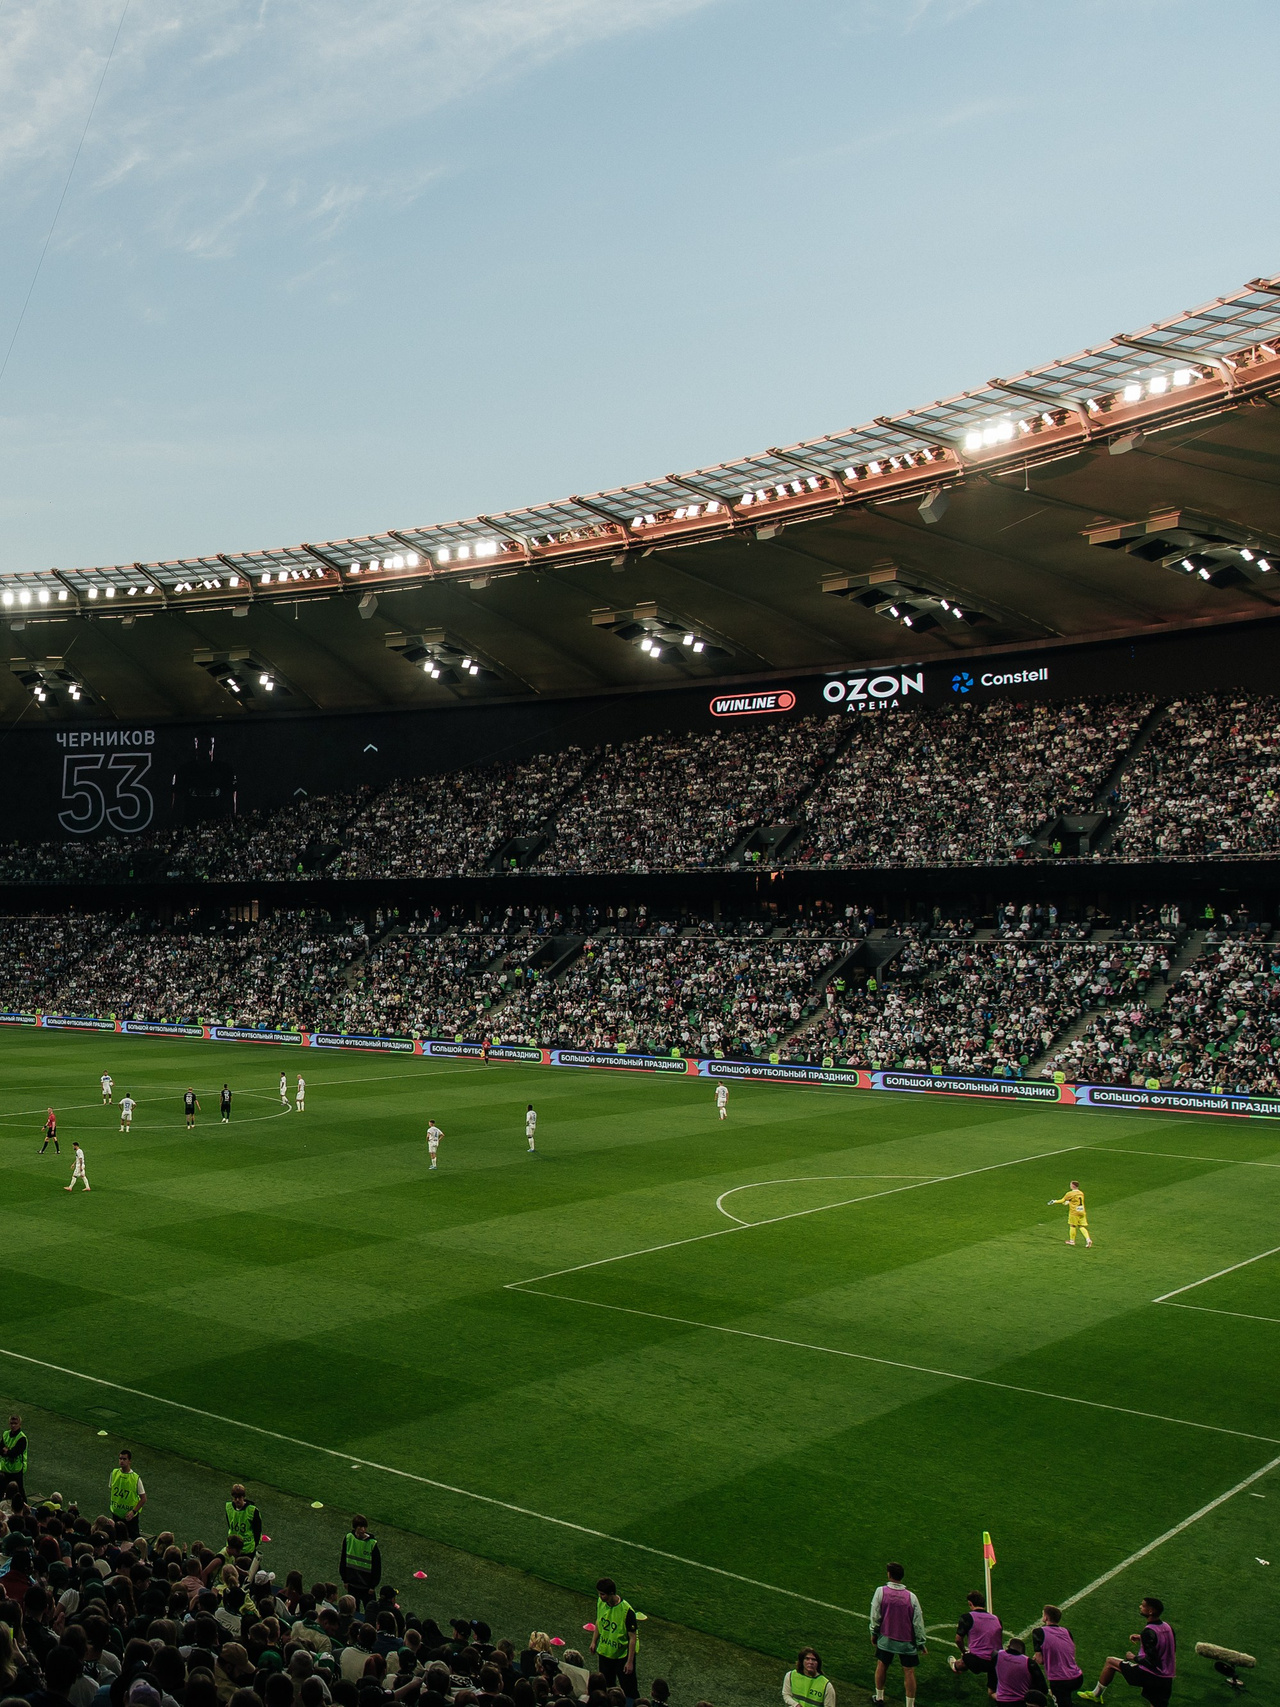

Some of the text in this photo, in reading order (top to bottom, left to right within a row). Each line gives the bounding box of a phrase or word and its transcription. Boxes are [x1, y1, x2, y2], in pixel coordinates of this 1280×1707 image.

[981, 668, 1048, 686] Constell
[823, 673, 923, 703] OZON
[716, 696, 776, 712] WINLINE
[847, 699, 899, 712] АРЕНА
[56, 730, 156, 748] ЧЕРНИКОВ
[58, 752, 154, 833] 53
[463, 1046, 504, 1057] ФУТБОНЫЙ
[561, 1054, 684, 1071] БОЛЬШОЙ ФУТБОЛЬНЫЙ ПРАЗДНИК!
[711, 1063, 855, 1084] БОЛЬШОЙ ФУТБОЛЬНЫЙ ПРАЗДНИК!
[886, 1076, 1055, 1098] БОЛЬШОЙ ФУТБОЛЬНЫЙ ПРАЗДНИК!
[1093, 1091, 1149, 1104] БОЛЬШОЙ
[1150, 1095, 1229, 1110] ФУТБОЛЬНЫЙ
[113, 1487, 130, 1500] 247
[111, 1500, 134, 1511] TEWARD
[809, 1689, 822, 1698] 270
